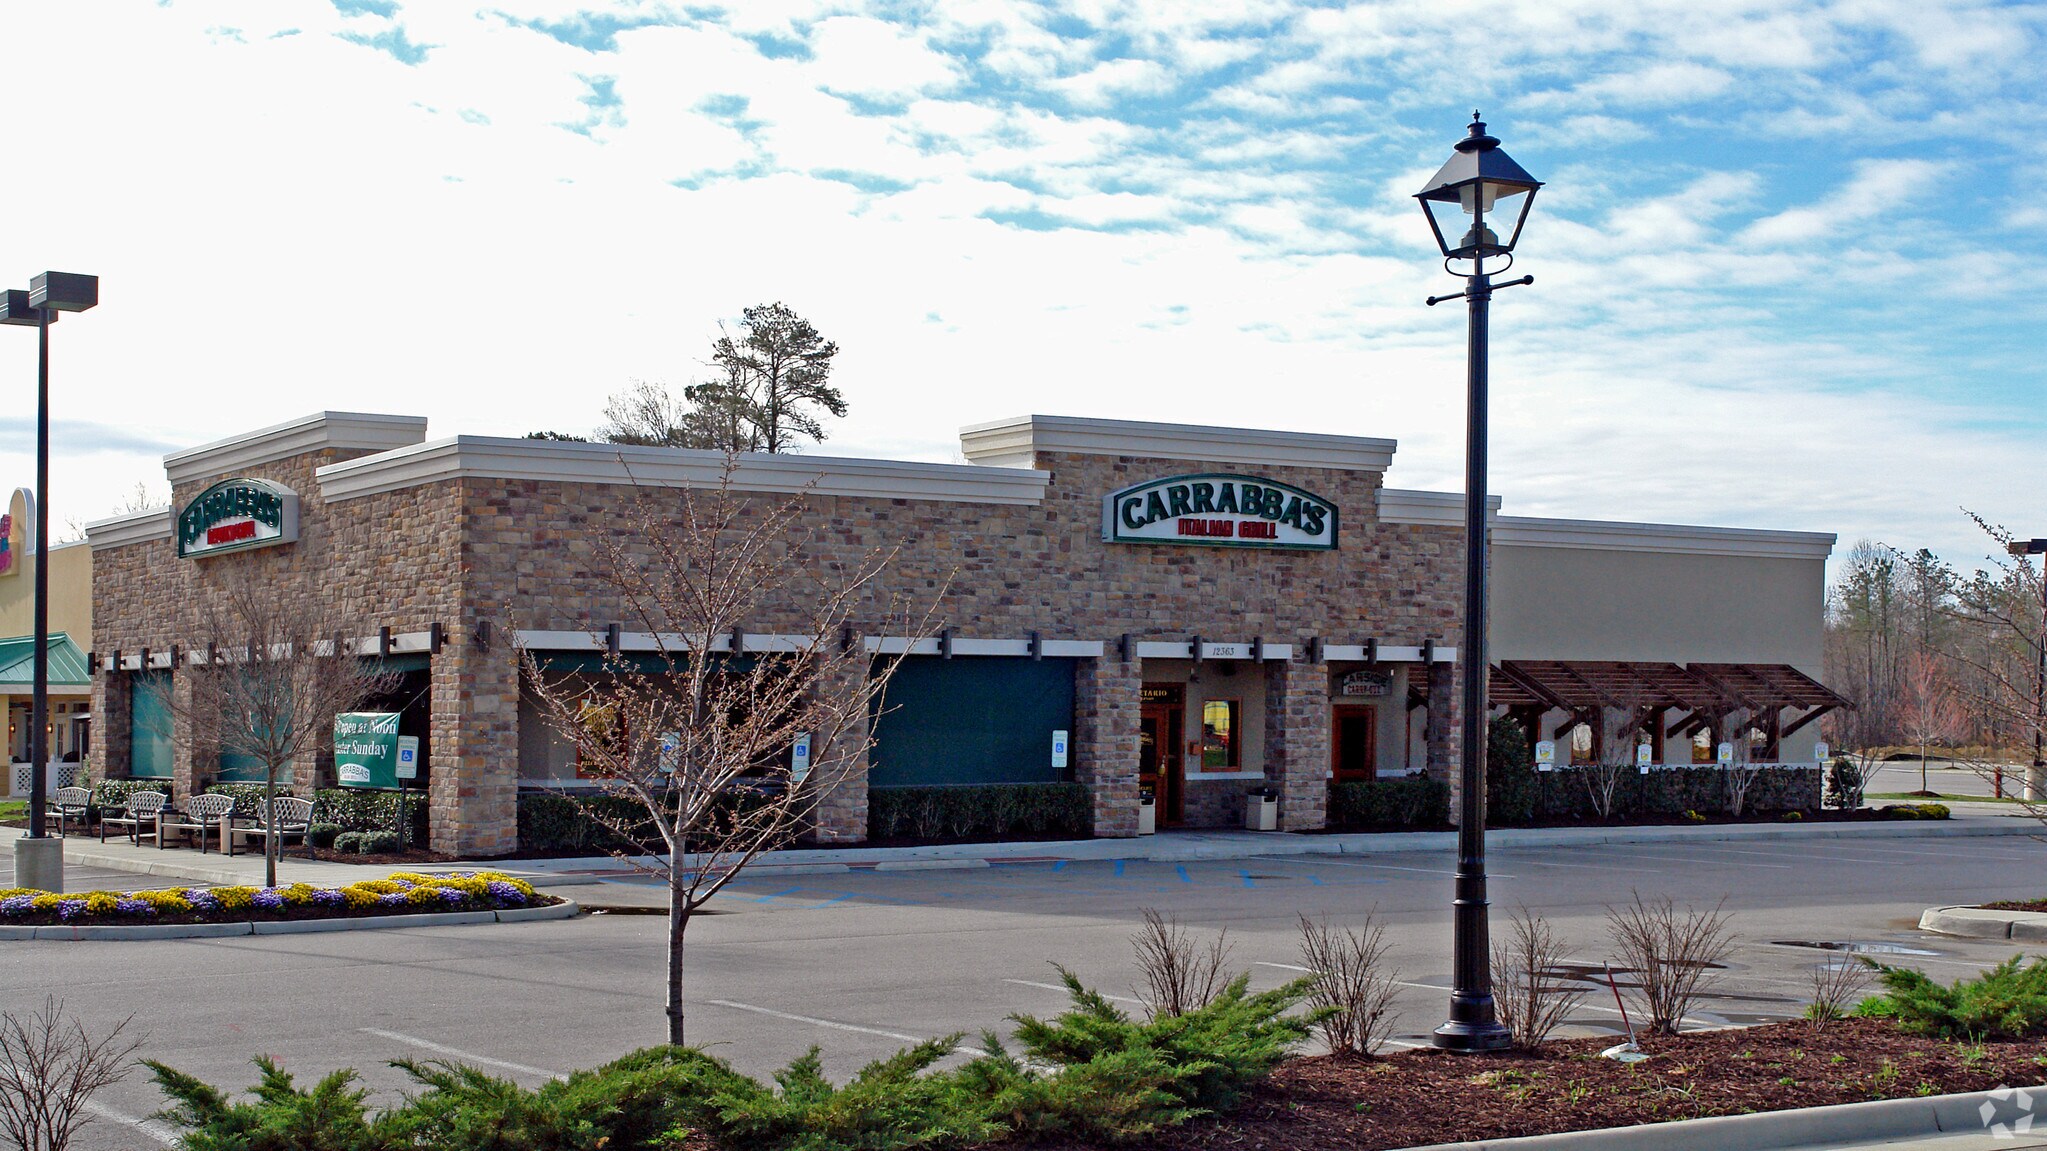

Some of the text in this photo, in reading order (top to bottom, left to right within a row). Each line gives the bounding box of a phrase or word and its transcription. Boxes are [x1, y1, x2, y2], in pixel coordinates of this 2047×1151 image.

[1122, 482, 1328, 536] CARRABBA'S
[1178, 518, 1279, 539] ITALIAN GRILL
[1212, 647, 1235, 656] 12363
[351, 740, 388, 759] Sunday
